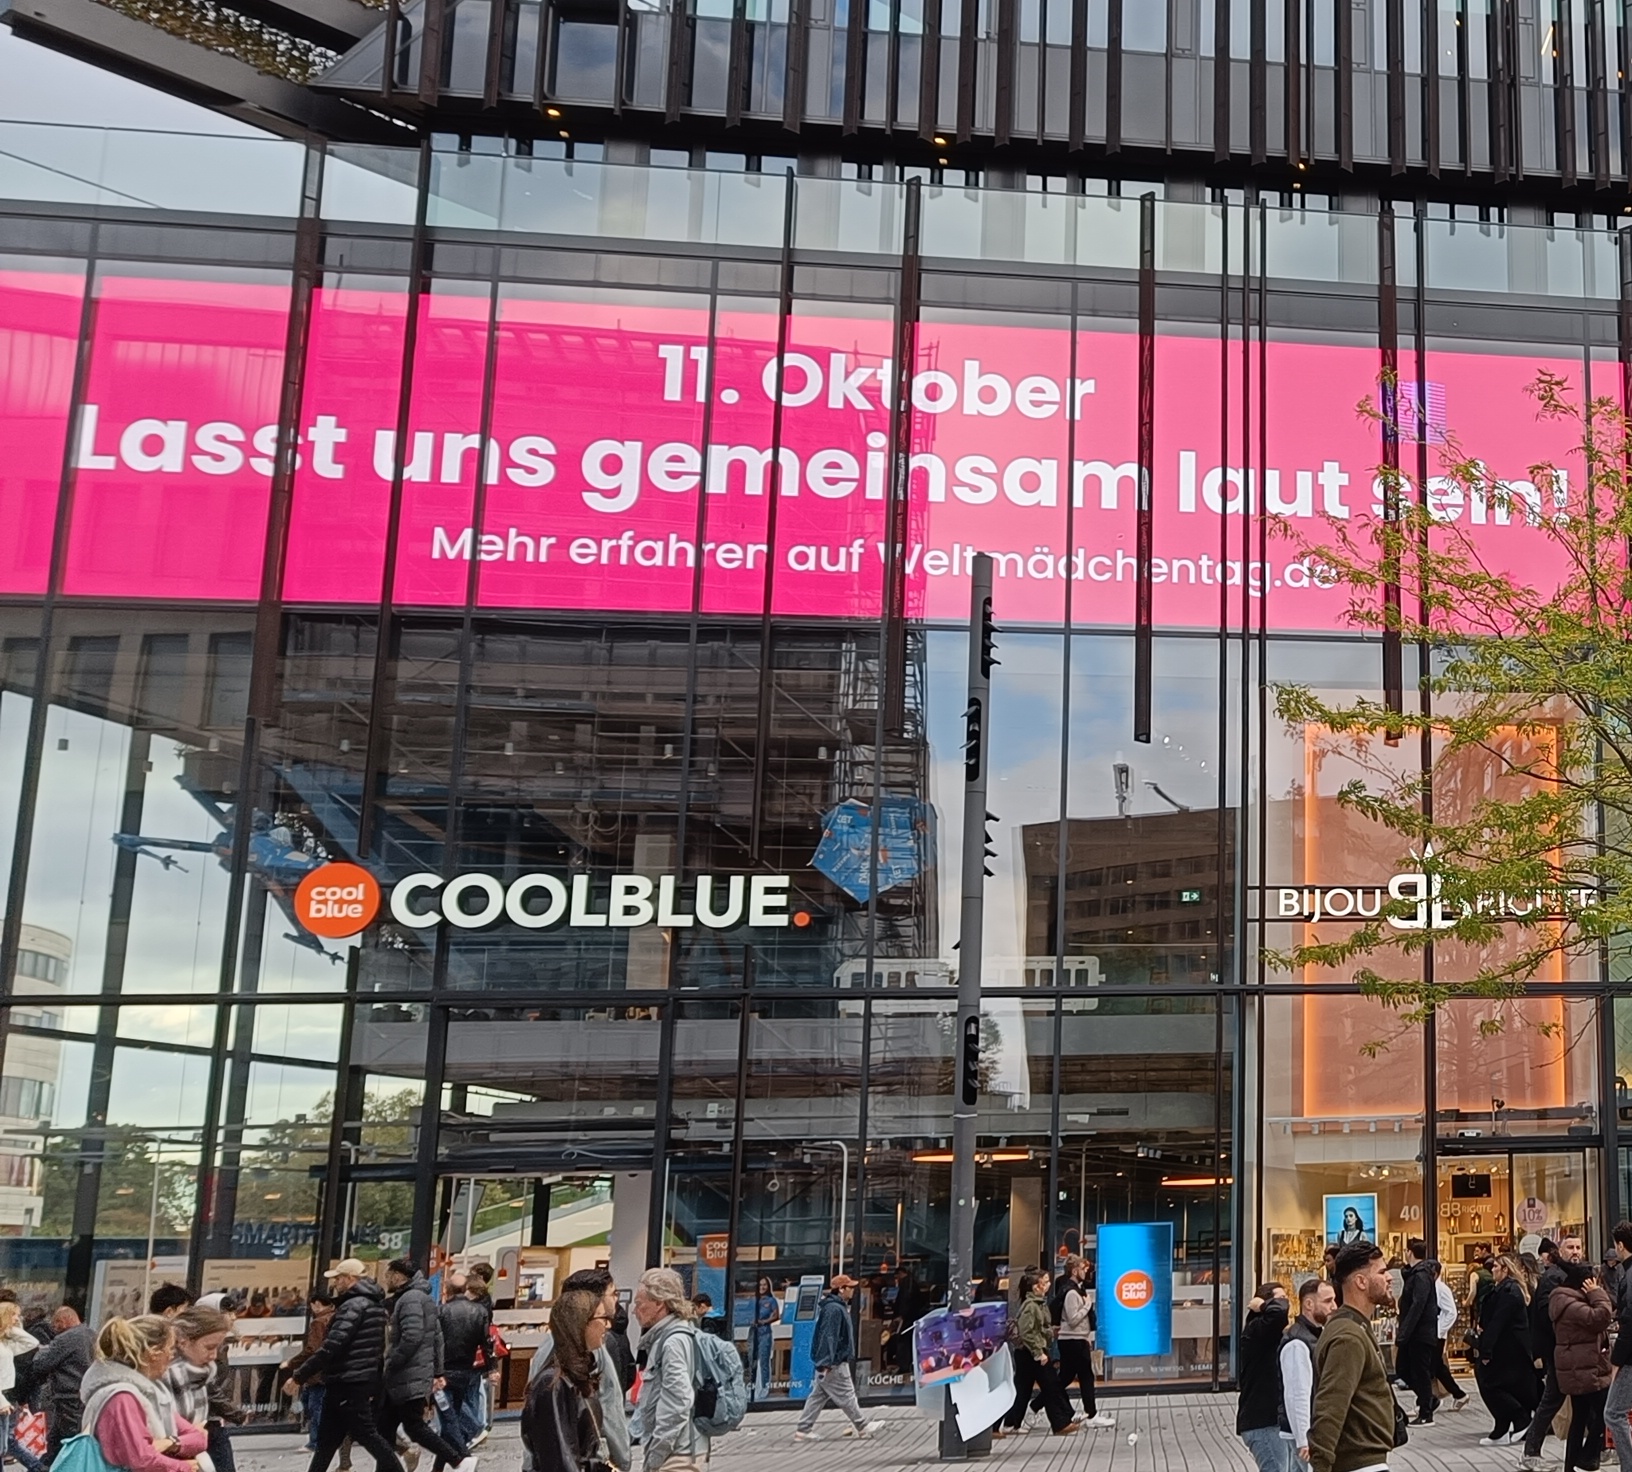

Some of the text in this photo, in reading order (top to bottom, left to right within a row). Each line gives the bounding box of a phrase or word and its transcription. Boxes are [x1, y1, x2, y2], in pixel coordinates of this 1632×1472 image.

[658, 344, 1096, 422] 11. Oktober
[72, 404, 1571, 527] Lasst uns gemeinsam laut sein!
[431, 526, 1337, 598] Mehr erfahren auf Weltmädchentag.de
[311, 883, 365, 904] cool
[390, 872, 810, 928] COOLBLUE.
[309, 896, 364, 919] blue
[1279, 888, 1381, 922] BIJOU
[1400, 1205, 1420, 1221] 40
[1522, 1208, 1543, 1222] 10%
[378, 1231, 403, 1250] 38
[706, 1241, 728, 1250] coo
[706, 1250, 728, 1260] blu
[1122, 1280, 1147, 1291] cool
[1122, 1290, 1147, 1300] blue
[867, 1373, 904, 1386] KÜCHE
